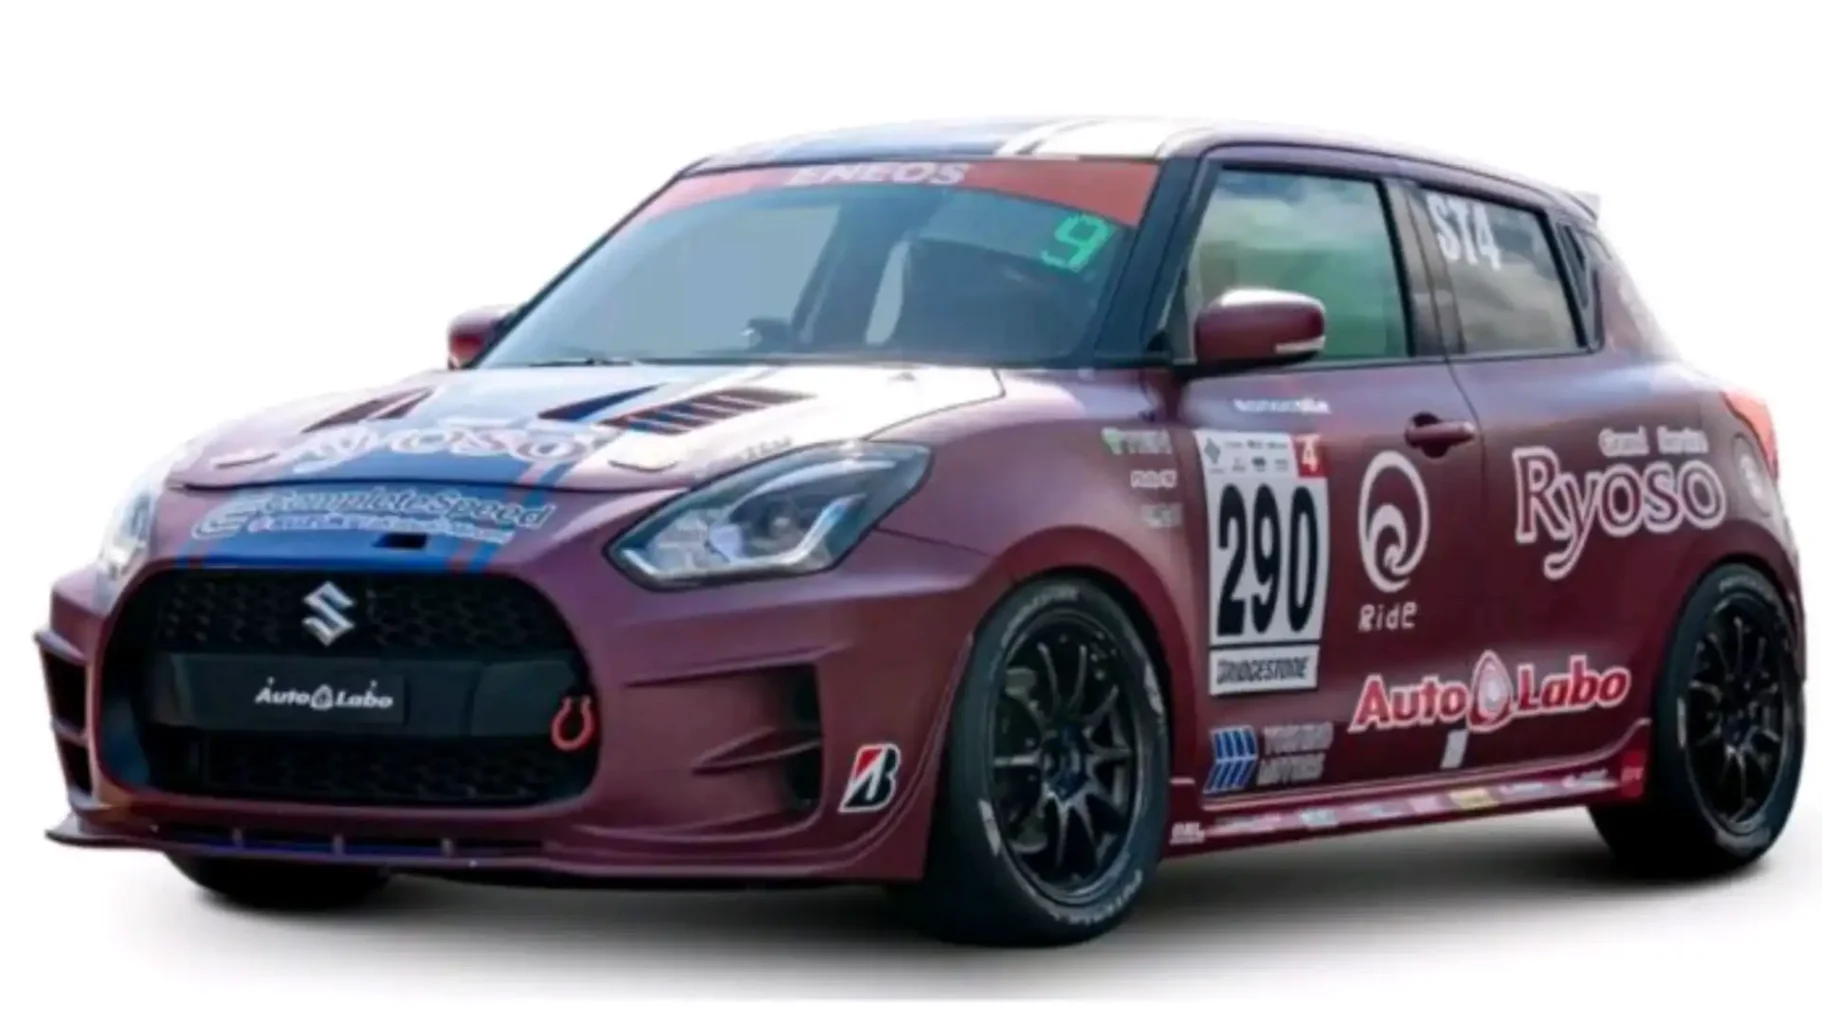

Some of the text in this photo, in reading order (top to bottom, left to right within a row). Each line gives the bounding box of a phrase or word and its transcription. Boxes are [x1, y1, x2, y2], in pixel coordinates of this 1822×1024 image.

[782, 162, 968, 187] ENEOS
[1426, 192, 1501, 271] ST4
[1512, 446, 1727, 580] Ryoso
[1215, 483, 1319, 637] 290
[255, 686, 394, 709] Auto Labo
[1345, 653, 1633, 734] Auto Labo
